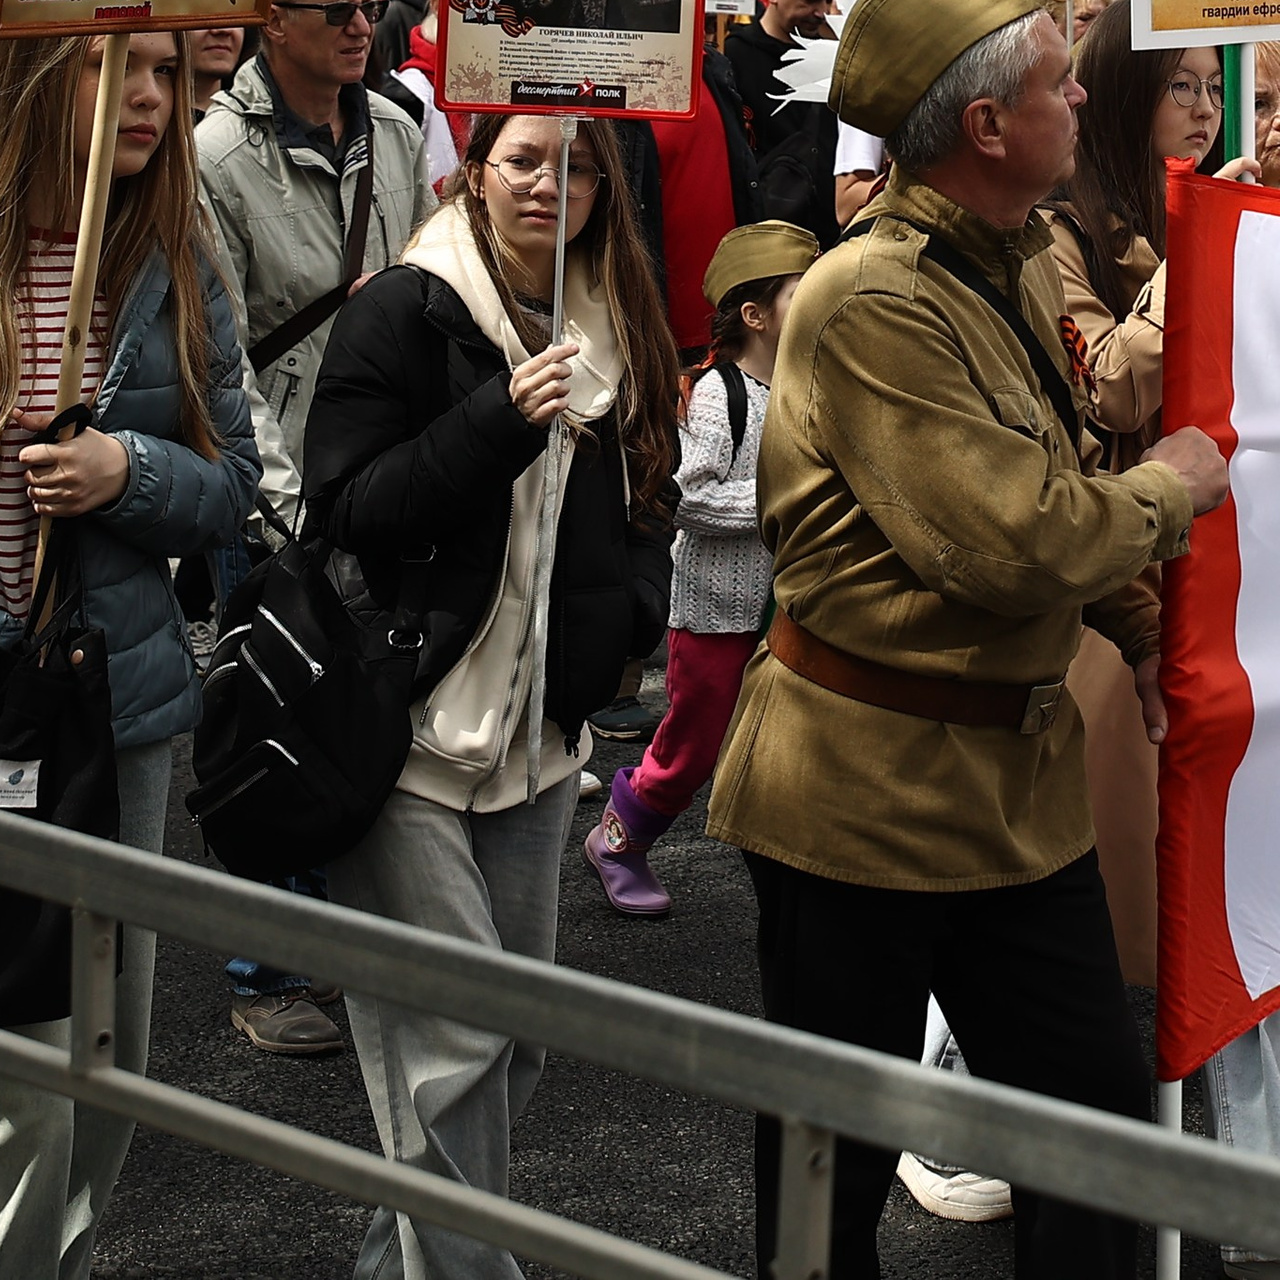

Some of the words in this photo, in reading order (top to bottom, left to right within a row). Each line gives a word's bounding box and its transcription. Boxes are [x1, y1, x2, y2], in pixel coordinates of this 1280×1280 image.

[1202, 5, 1250, 20] гвардии
[539, 28, 574, 37] ГОРЯЧЕВ
[575, 30, 615, 39] НИКОЛАЙ
[616, 32, 644, 40] ИЛЬИЧ
[595, 89, 620, 98] ПОЛК
